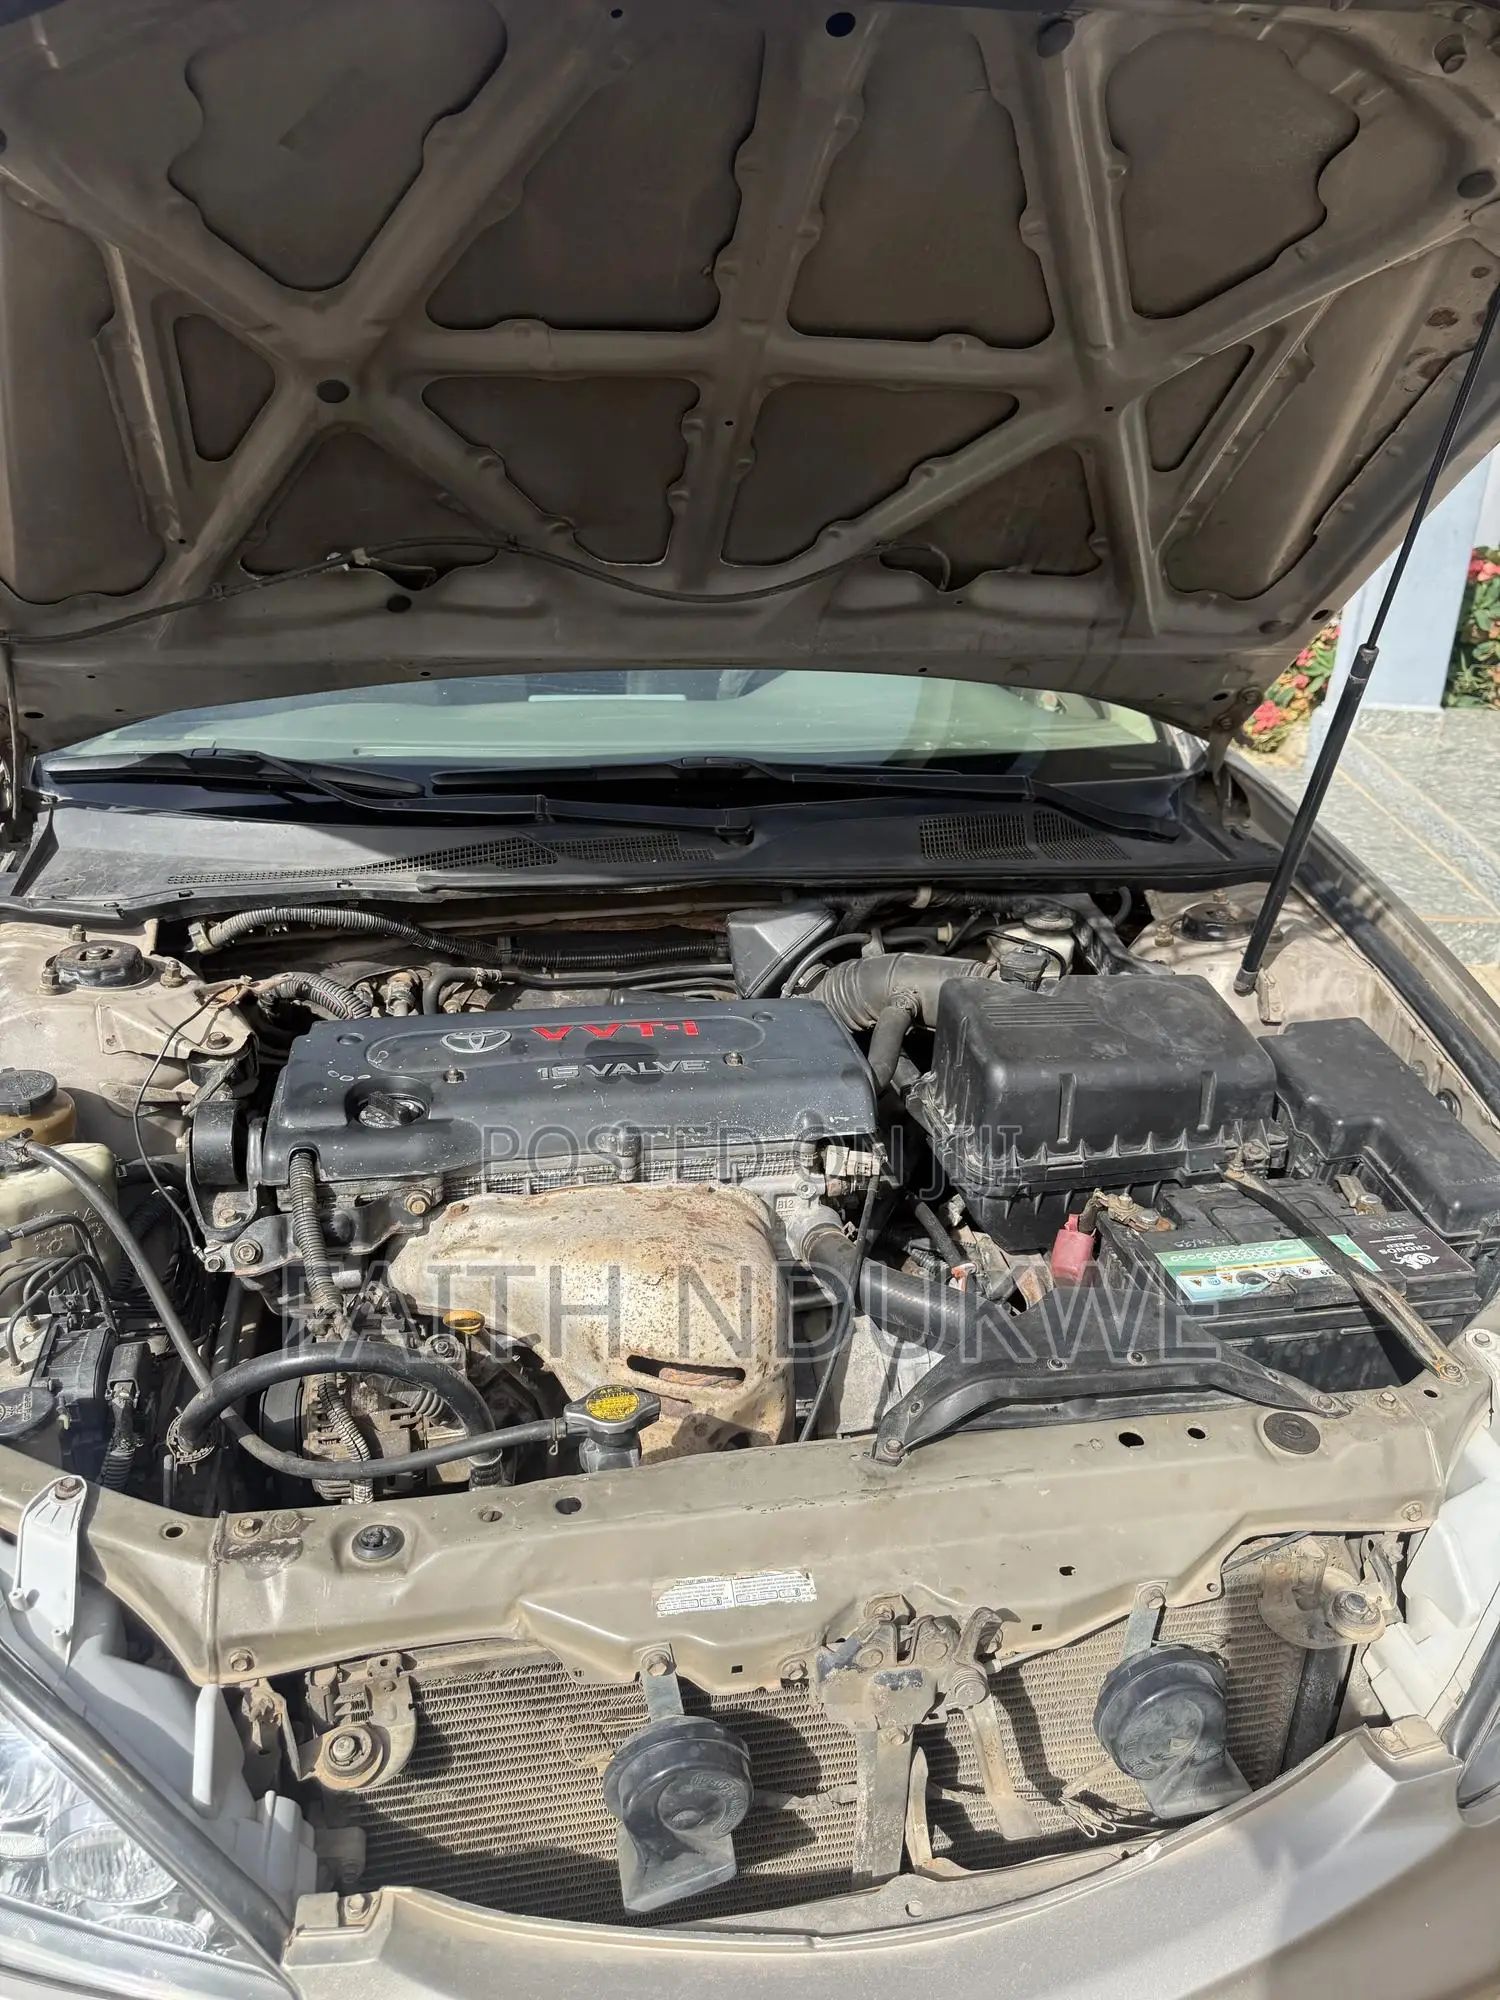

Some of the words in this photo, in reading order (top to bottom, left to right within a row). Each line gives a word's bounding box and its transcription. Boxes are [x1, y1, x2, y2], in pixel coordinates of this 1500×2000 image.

[537, 1065, 581, 1080] 16
[586, 1060, 710, 1077] VALVE
[1379, 1244, 1431, 1254] CRONOS
